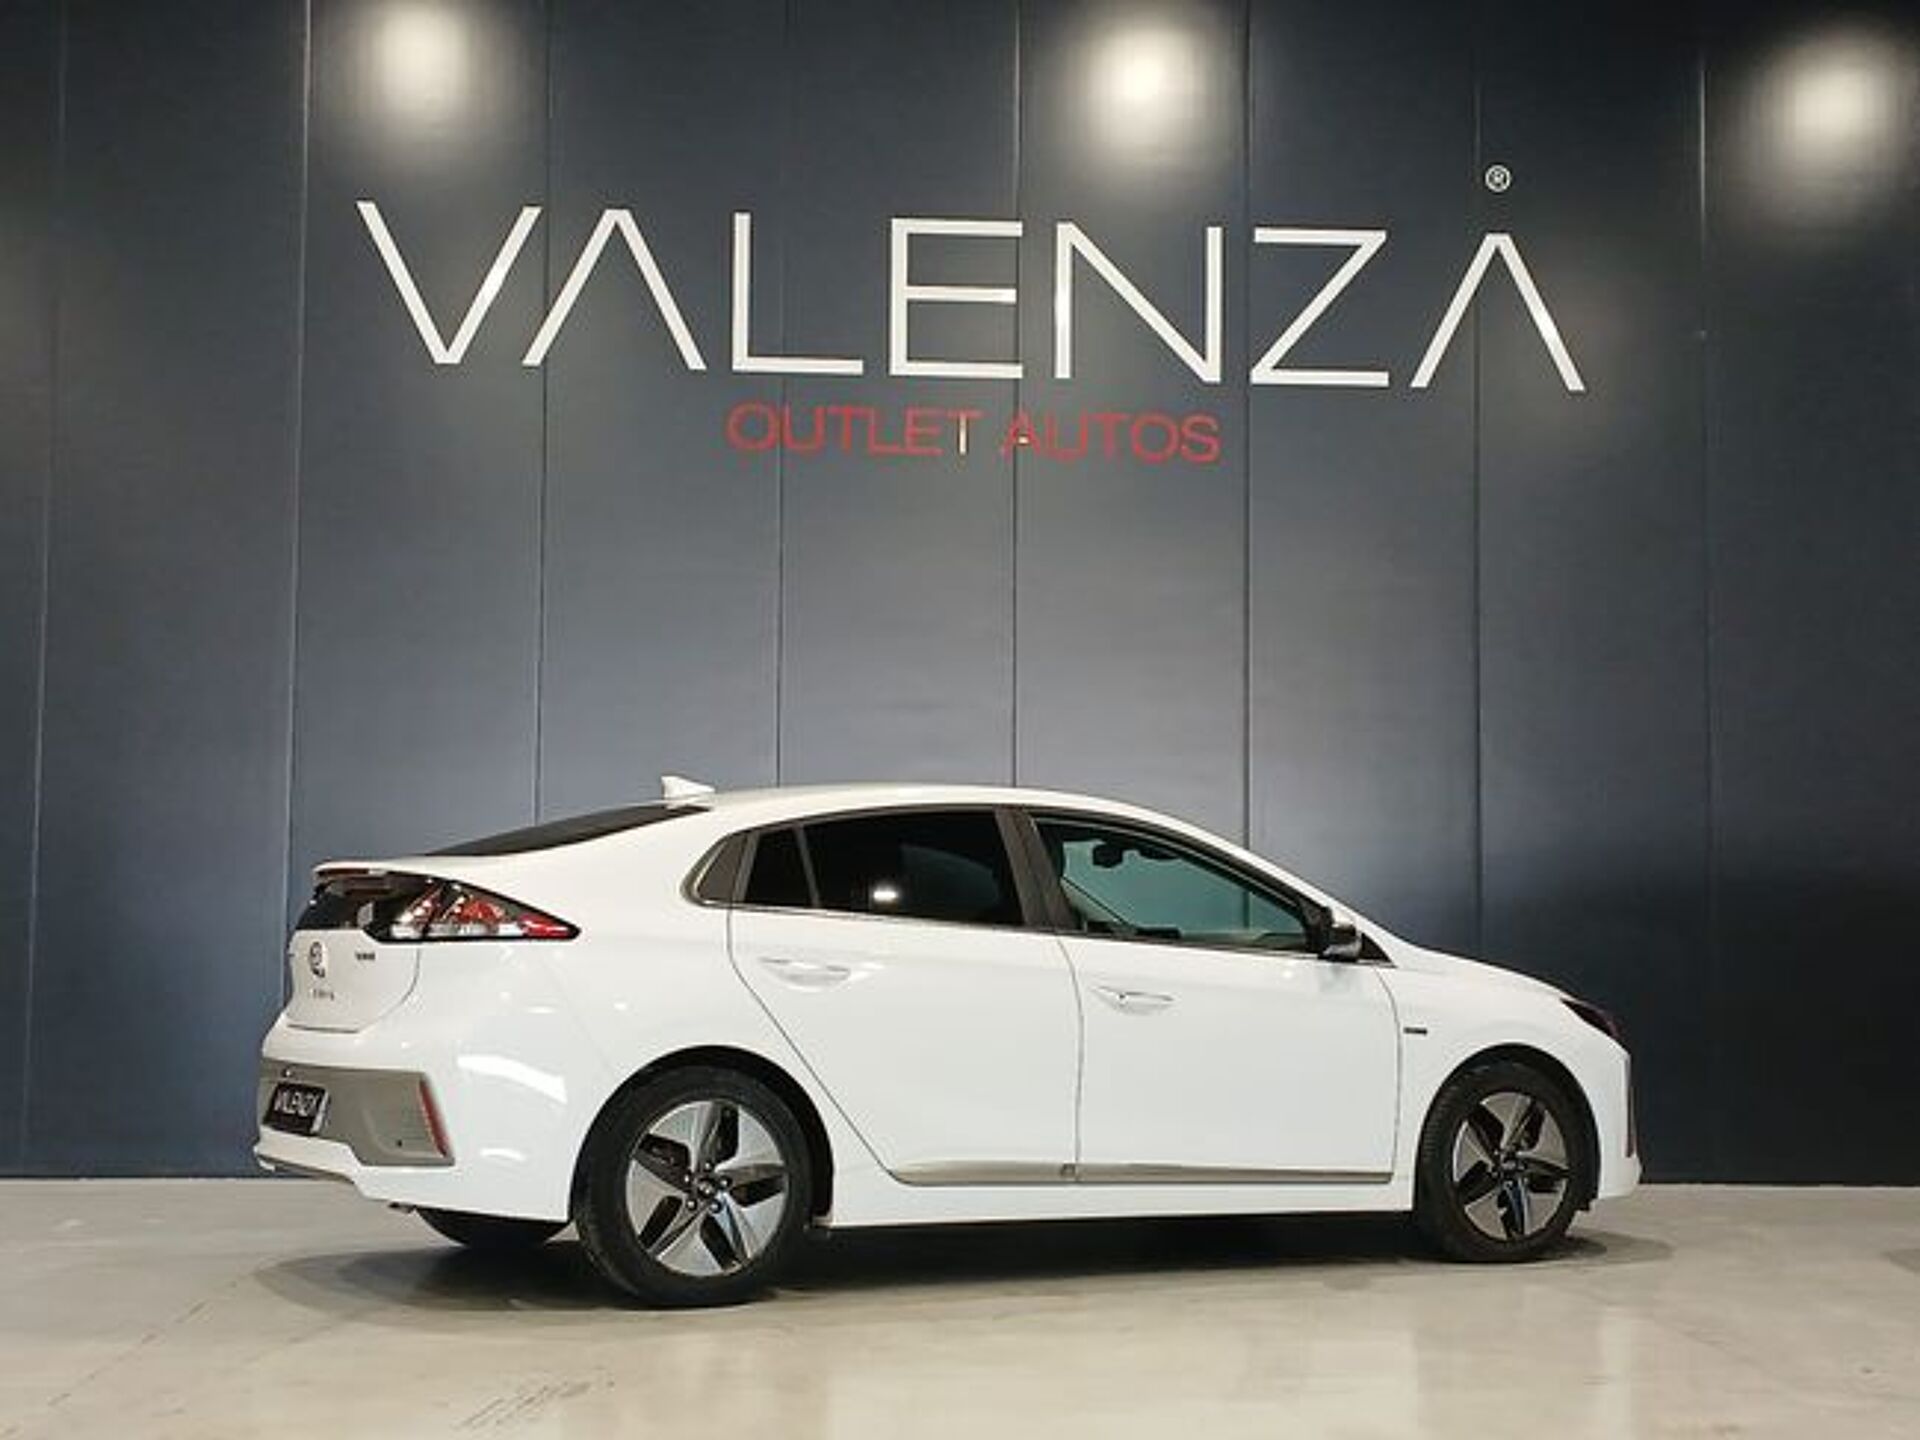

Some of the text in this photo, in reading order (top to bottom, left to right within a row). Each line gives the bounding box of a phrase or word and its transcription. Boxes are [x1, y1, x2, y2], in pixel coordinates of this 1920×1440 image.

[356, 200, 1586, 392] VALENZA
[726, 403, 1221, 464] OUTLET AUTOS
